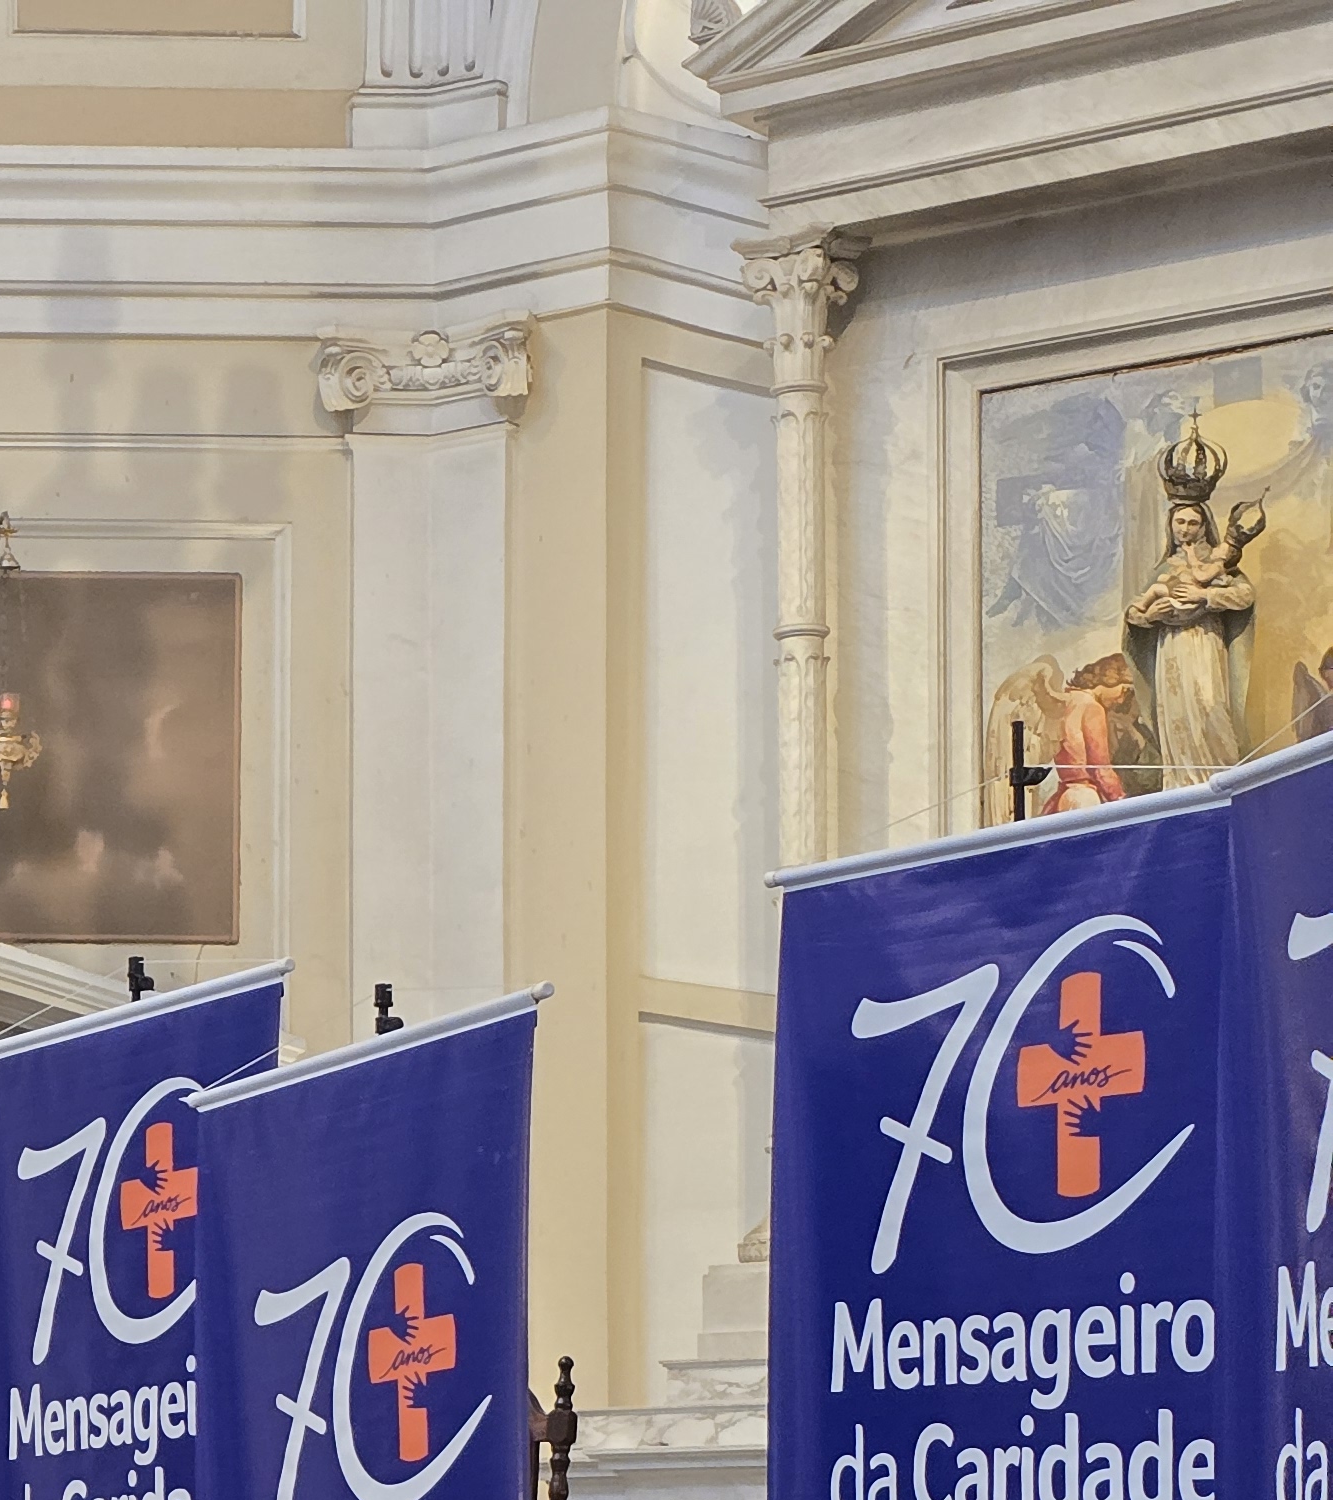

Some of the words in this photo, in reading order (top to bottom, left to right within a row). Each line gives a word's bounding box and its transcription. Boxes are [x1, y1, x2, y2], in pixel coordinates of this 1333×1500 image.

[1031, 1065, 1132, 1102] anos
[131, 1193, 191, 1226] anos
[831, 1272, 1214, 1410] Mensageiro
[379, 1344, 447, 1379] anos
[9, 1355, 197, 1465] Mensagei
